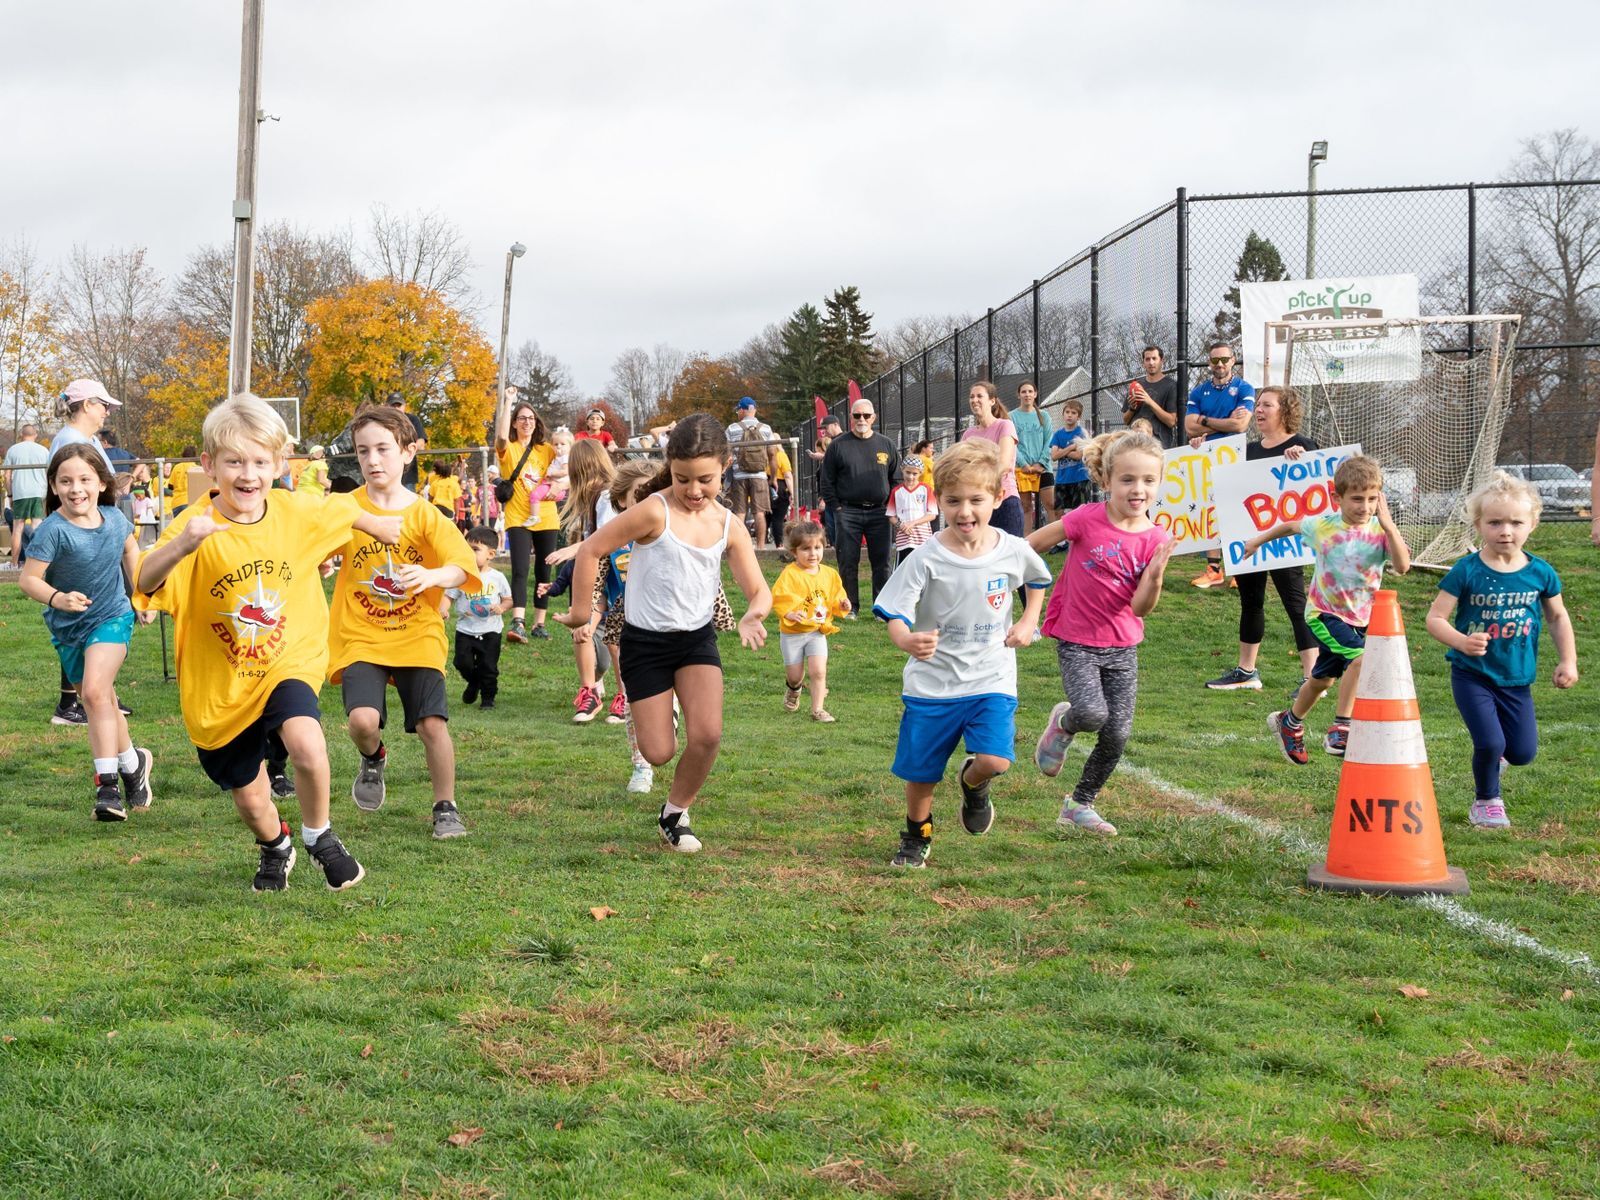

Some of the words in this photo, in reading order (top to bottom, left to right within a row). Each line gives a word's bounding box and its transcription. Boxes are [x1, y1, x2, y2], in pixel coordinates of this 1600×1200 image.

[1288, 290, 1328, 310] pick
[1348, 292, 1372, 306] up
[403, 545, 423, 565] FOR
[210, 559, 274, 600] STRIDES
[353, 590, 420, 618] EDUCATIO
[1481, 610, 1500, 620] we
[1502, 607, 1526, 620] are
[237, 670, 266, 678] 11-6-22
[1349, 798, 1423, 835] NTS
